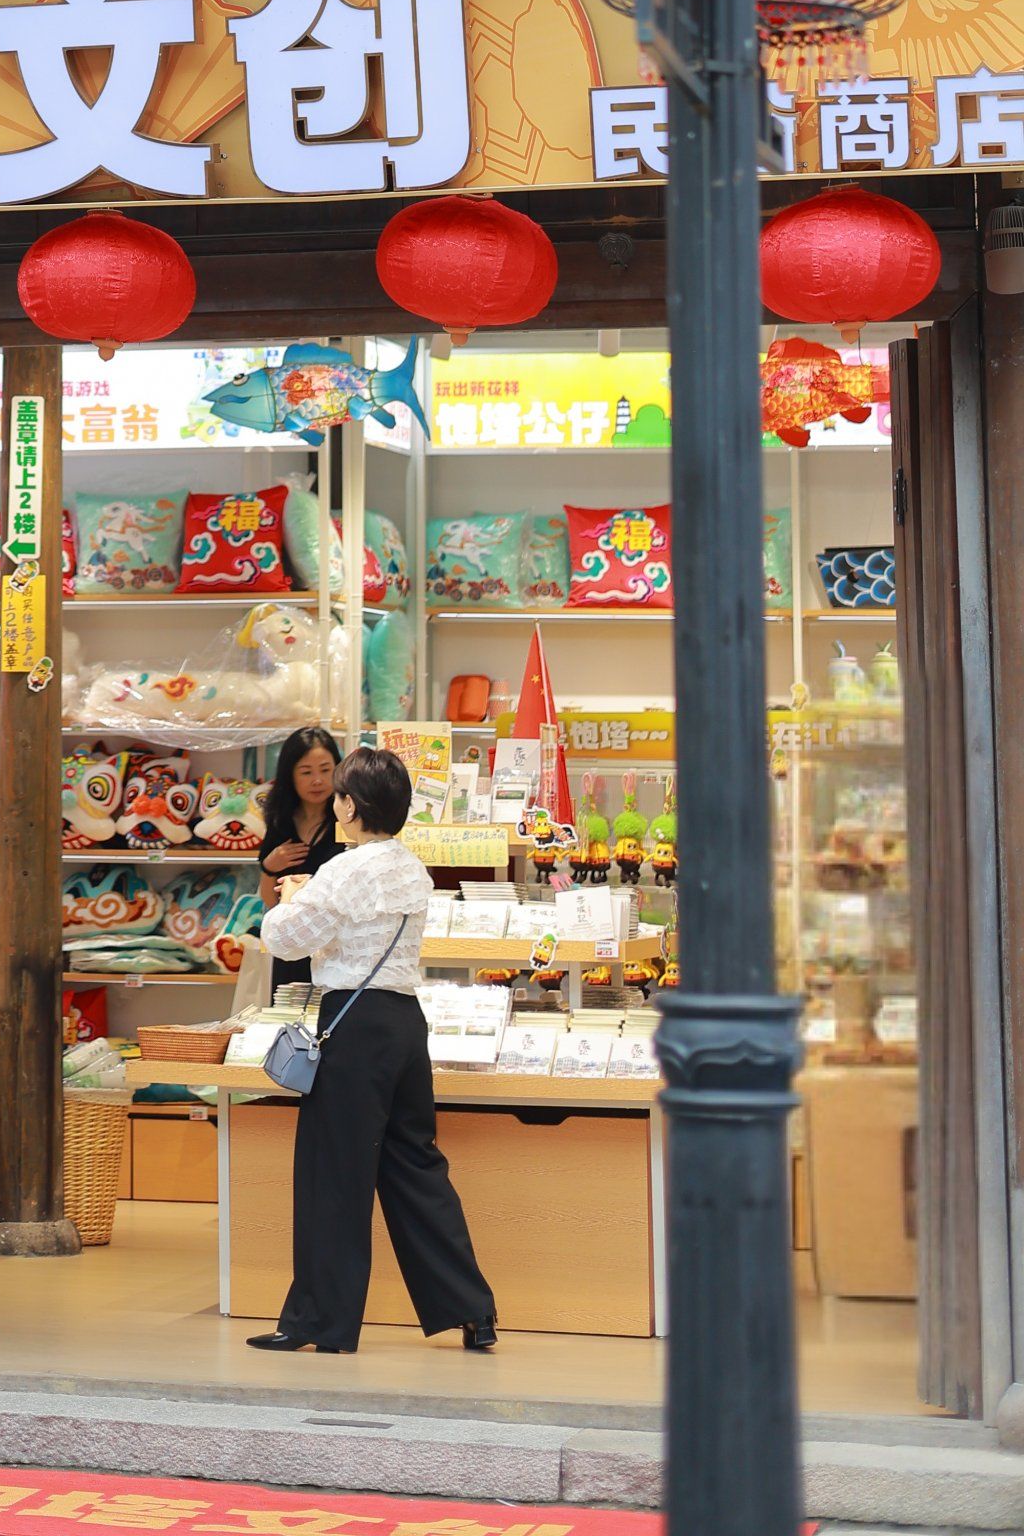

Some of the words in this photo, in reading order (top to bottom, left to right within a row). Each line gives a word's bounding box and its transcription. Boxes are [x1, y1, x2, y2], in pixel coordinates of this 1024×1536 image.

[434, 380, 521, 397] 玩出新花样
[14, 400, 39, 535] 盖章请上2楼
[218, 499, 263, 533] 福
[609, 519, 653, 552] 福
